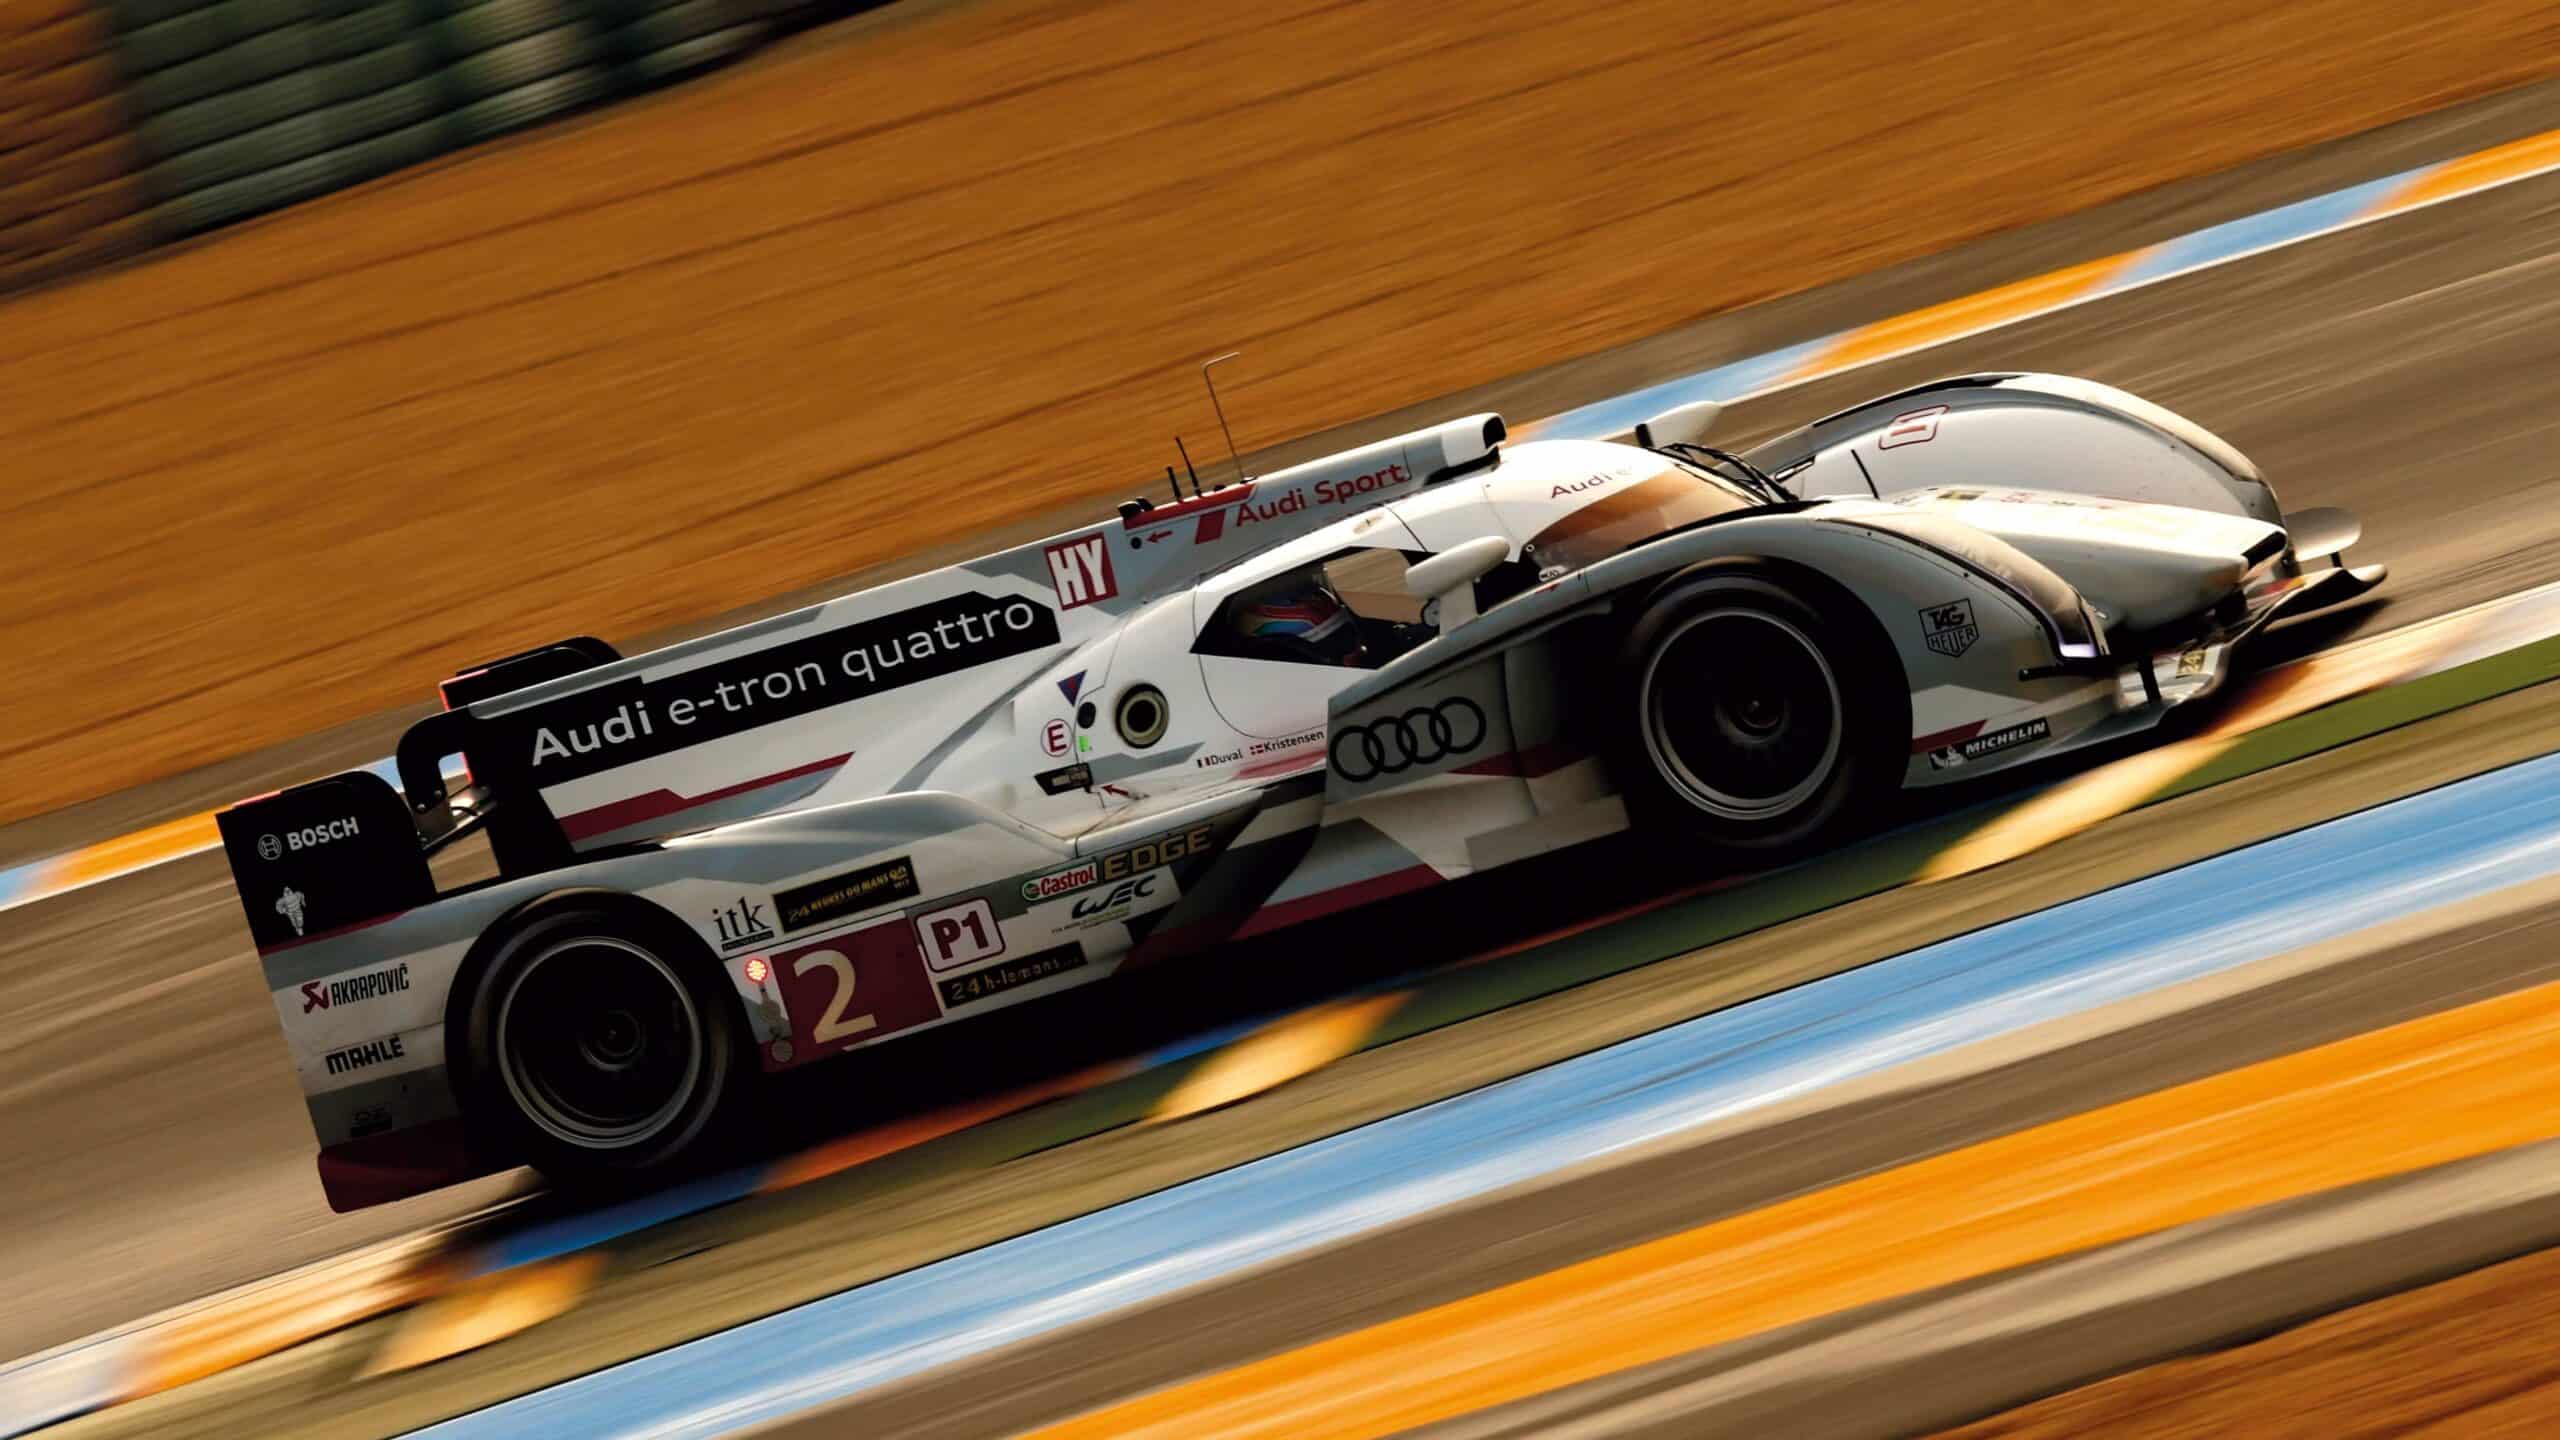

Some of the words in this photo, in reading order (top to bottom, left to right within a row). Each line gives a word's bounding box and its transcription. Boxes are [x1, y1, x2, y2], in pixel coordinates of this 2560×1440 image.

[1236, 487, 1307, 528] Audi
[1314, 463, 1408, 505] Sport
[1551, 474, 1613, 499] Audi
[1049, 538, 1107, 606] HY
[1928, 605, 1965, 630] TAG
[1928, 627, 1976, 650] HEUER
[532, 700, 653, 766] Audi
[668, 661, 826, 725] e-tron
[841, 601, 1034, 682] quattro
[1047, 723, 1067, 753] E
[1210, 749, 1243, 766] Duval
[1263, 730, 1325, 753] Kristensen
[1965, 721, 2046, 755] MICHELIN
[286, 816, 360, 851] BOSCH
[1040, 865, 1095, 896] Castrol
[1103, 825, 1210, 881] EDGE
[1072, 874, 1157, 919] WEC
[712, 896, 772, 941] itk
[931, 910, 989, 961] P1
[331, 963, 409, 1007] AKRAPOVIČ
[793, 949, 877, 1044] 2
[326, 1034, 404, 1075] MAHLE
